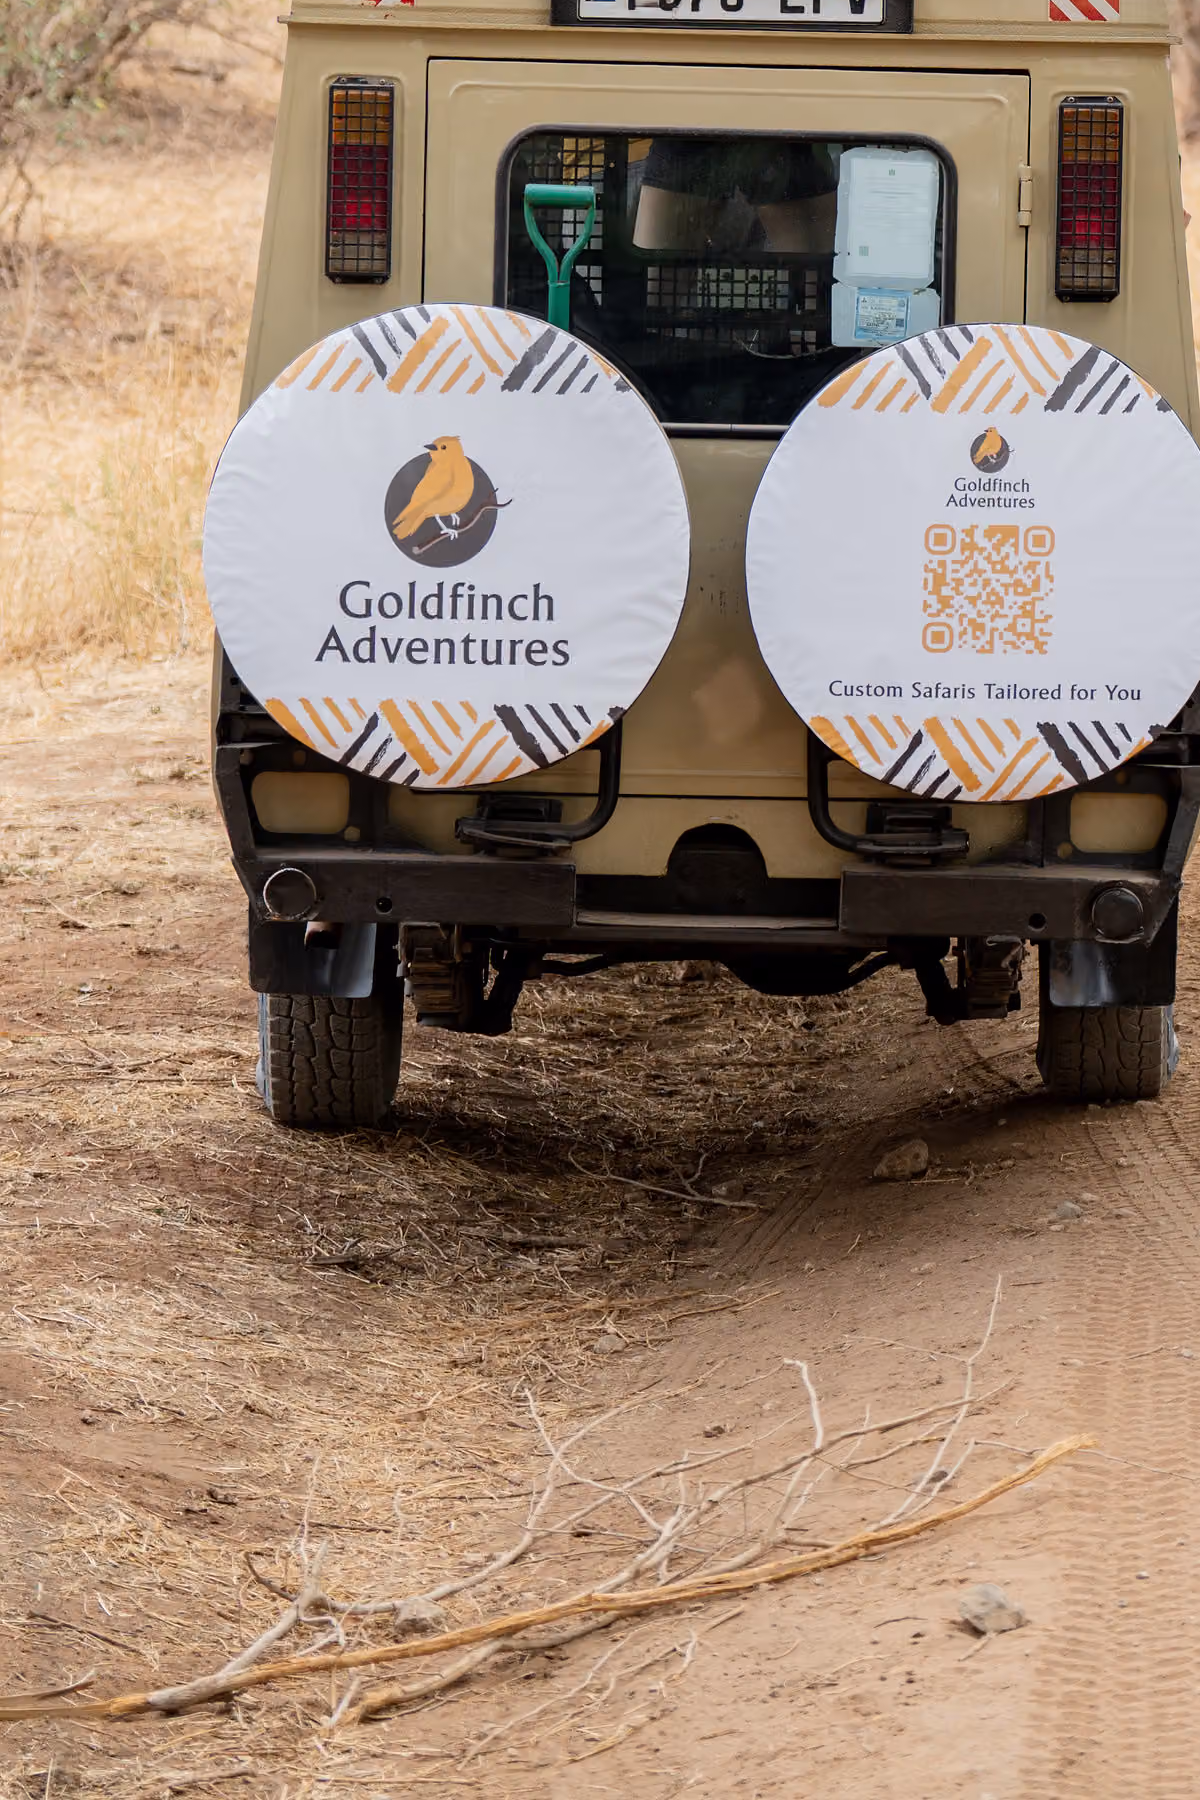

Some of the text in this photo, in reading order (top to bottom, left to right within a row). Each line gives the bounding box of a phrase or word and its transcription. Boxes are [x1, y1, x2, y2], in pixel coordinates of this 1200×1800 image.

[954, 477, 1030, 493] Goldfinch
[945, 493, 1035, 509] Adventures
[339, 580, 554, 621] Goldfinch
[314, 624, 570, 667] Adventures
[828, 680, 1142, 701] Custom Safaris Tailored for You
